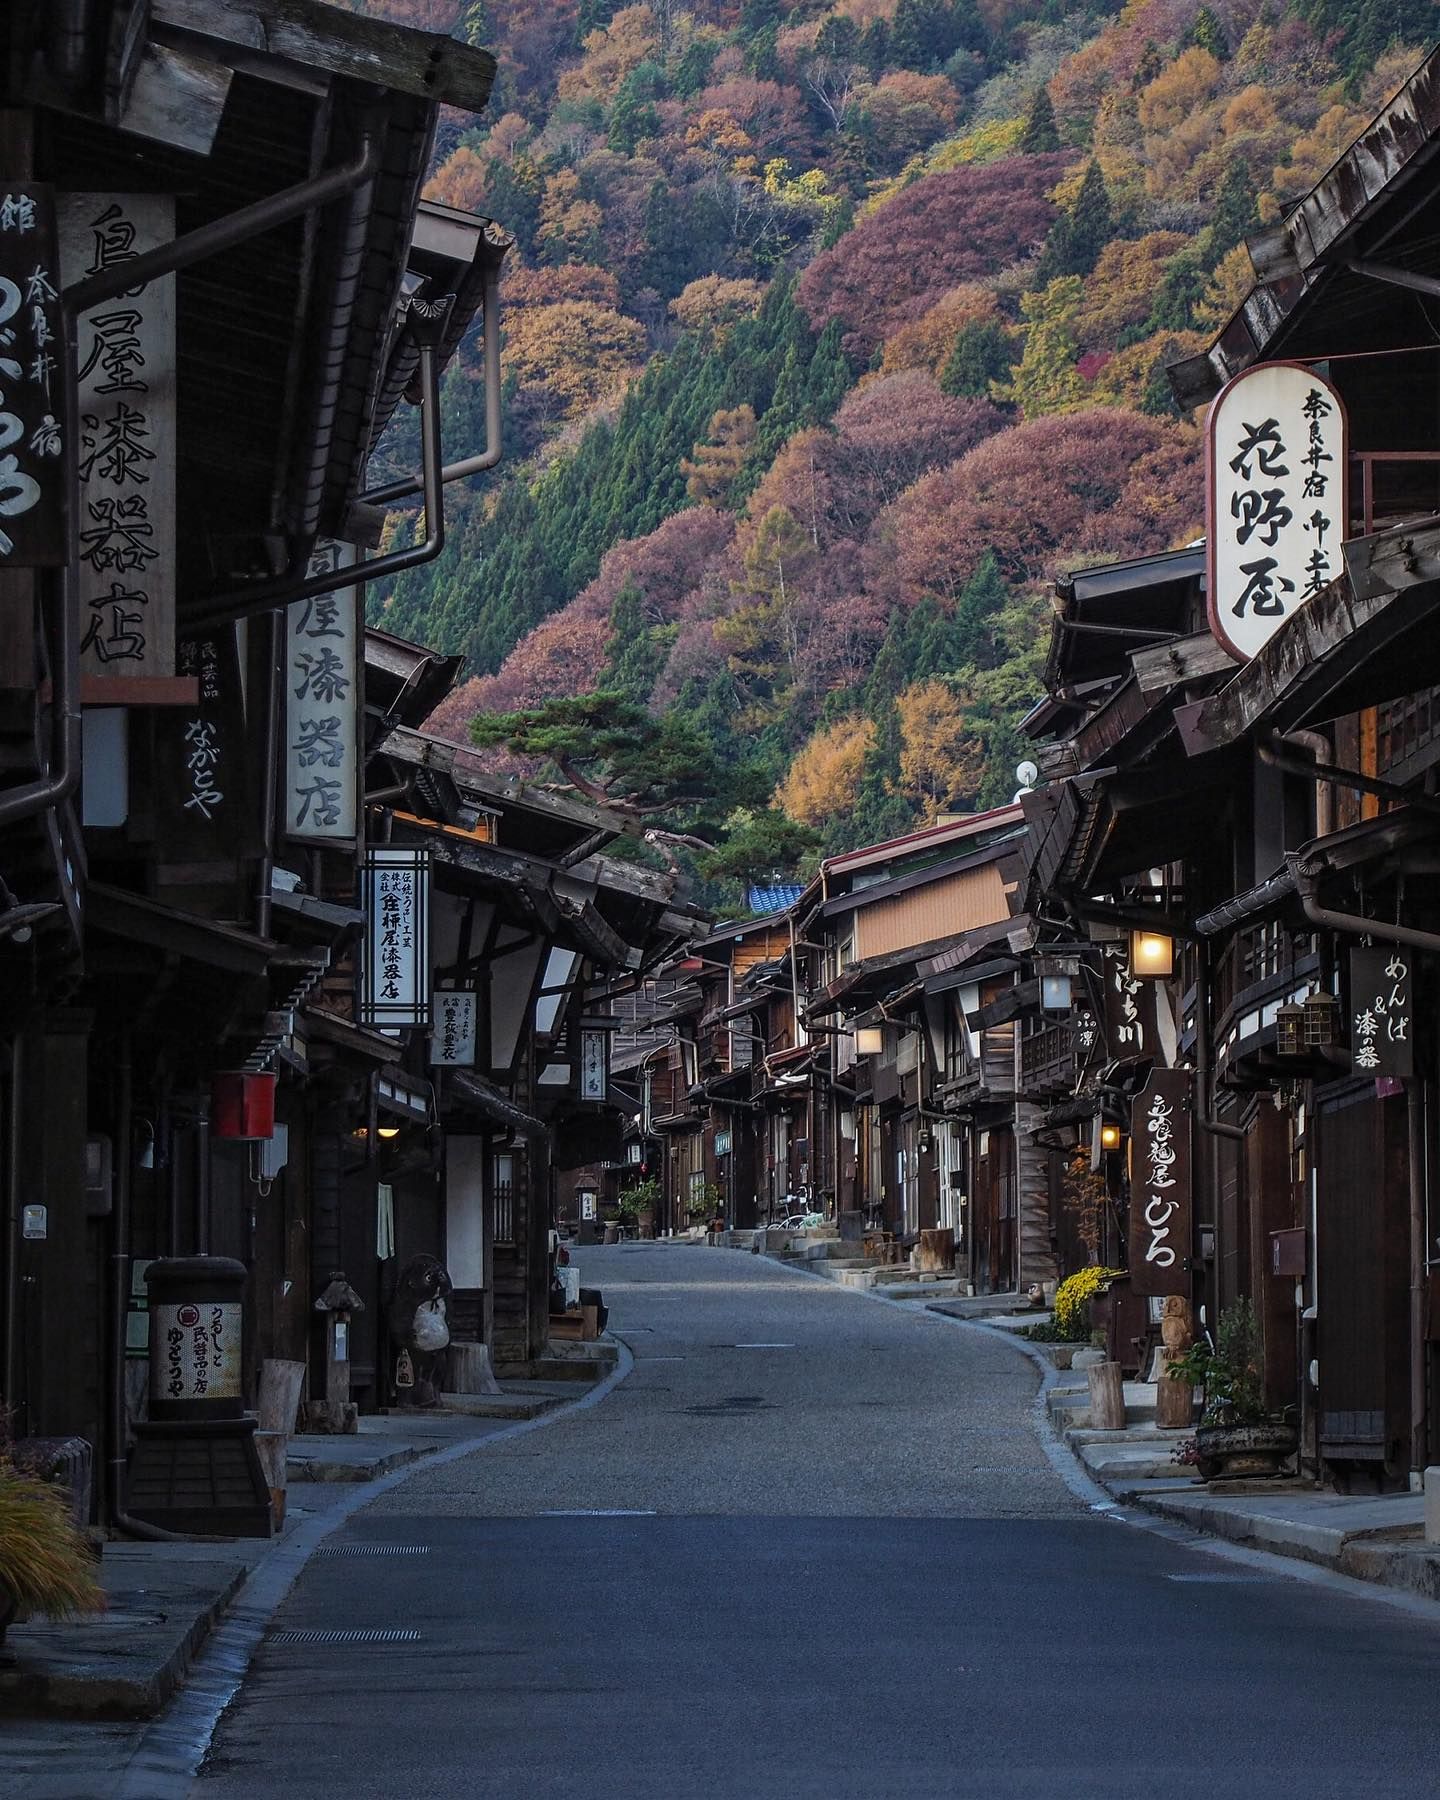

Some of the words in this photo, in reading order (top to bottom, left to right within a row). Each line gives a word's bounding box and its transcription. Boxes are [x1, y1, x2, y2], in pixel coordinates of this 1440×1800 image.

[1301, 388, 1333, 499] 奈良井宿
[1228, 417, 1296, 619] 花野屋
[183, 718, 225, 819] ながとや
[1354, 1008, 1382, 1068] 漆の器
[1374, 995, 1388, 1015] &
[1384, 953, 1410, 1042] めんぱ
[1145, 1194, 1180, 1267] ひろ
